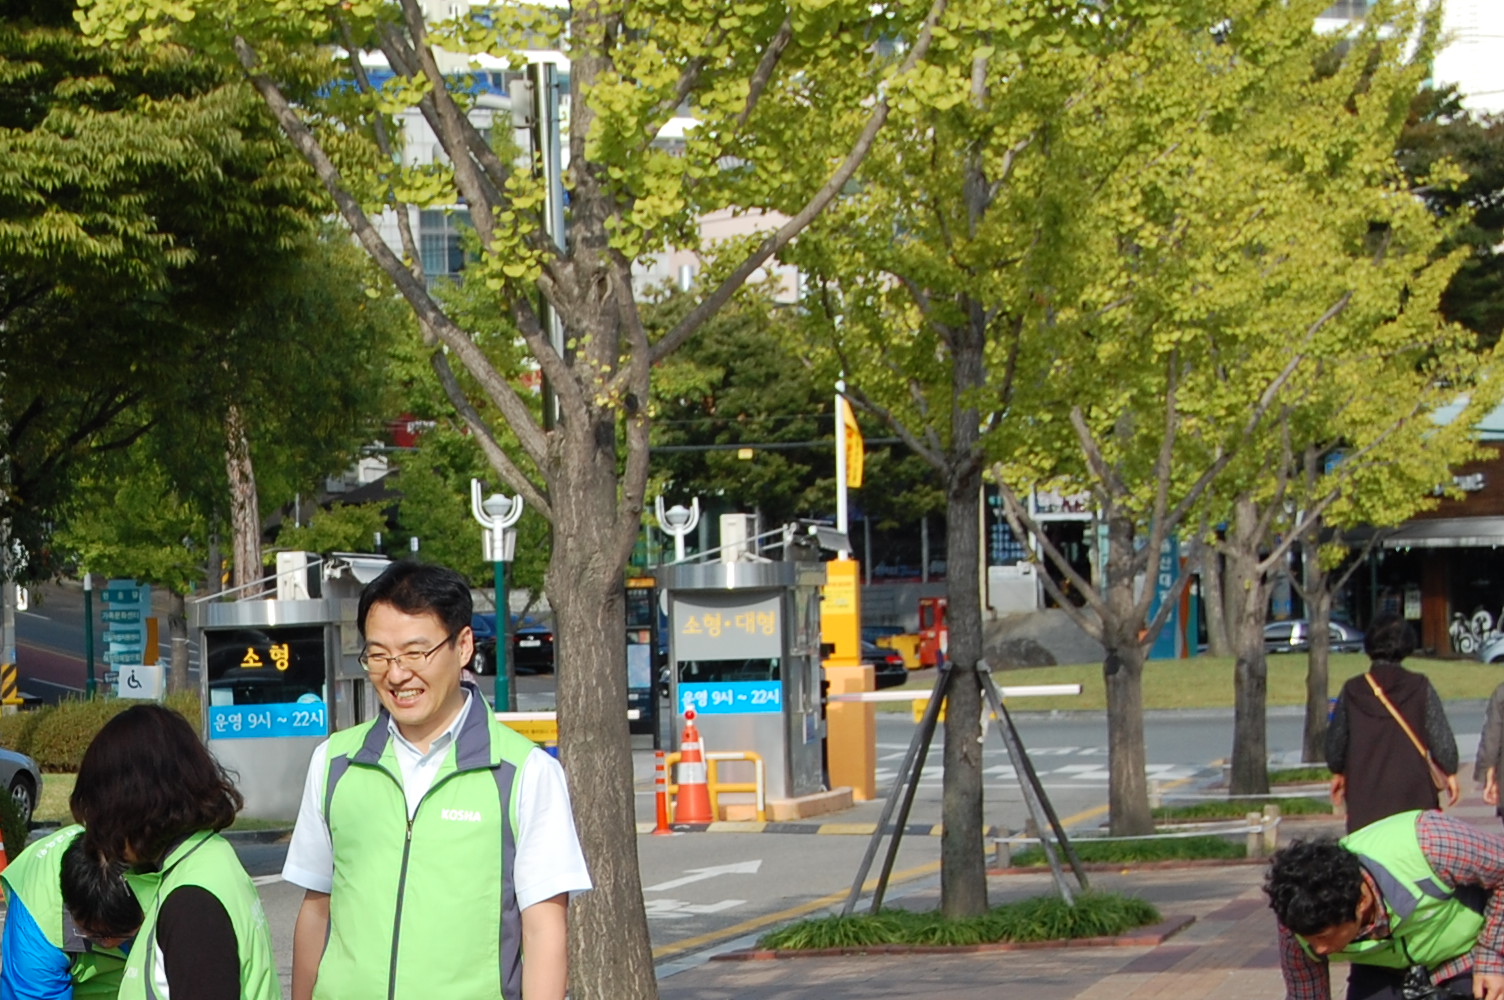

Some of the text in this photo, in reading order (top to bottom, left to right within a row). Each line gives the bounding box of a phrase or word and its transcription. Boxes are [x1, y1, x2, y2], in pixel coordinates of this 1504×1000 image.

[711, 688, 733, 706] 9시
[750, 688, 780, 705] 22시
[214, 712, 242, 732] 운영
[248, 711, 271, 729] 9시
[292, 709, 324, 728] 22시
[441, 808, 481, 822] KOSHA
